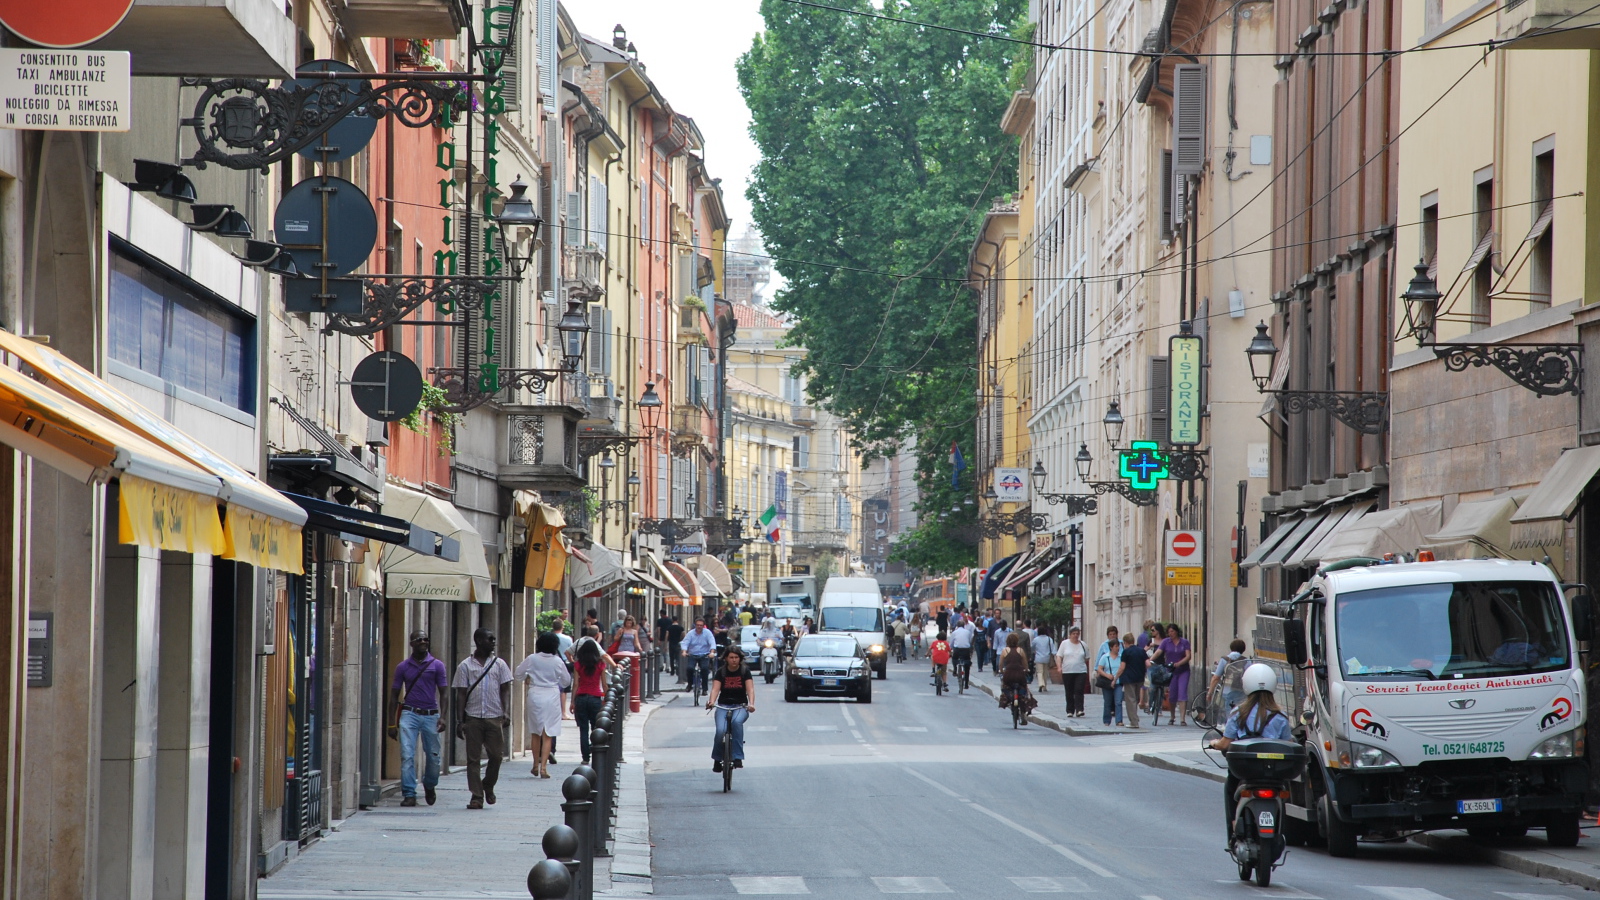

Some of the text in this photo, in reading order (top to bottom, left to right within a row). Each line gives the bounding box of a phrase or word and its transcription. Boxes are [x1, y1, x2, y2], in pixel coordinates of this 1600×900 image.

[20, 53, 106, 67] CONSENTITO BUS
[16, 67, 106, 82] TAXI AMBULANZE
[34, 83, 89, 97] BICICLETTE
[5, 98, 119, 112] NOLEGGIO DA RIMESSA
[6, 113, 118, 127] IN CORSIA RISERVATA
[1178, 343, 1192, 438] RISTORANTE
[1036, 537, 1050, 548] BAR
[395, 578, 461, 596] Pasticceria
[580, 572, 616, 594] Fast Food
[1366, 675, 1553, 694] Servizi Tecnologici Ambientali
[1422, 741, 1505, 756] Tel. 0521/648725
